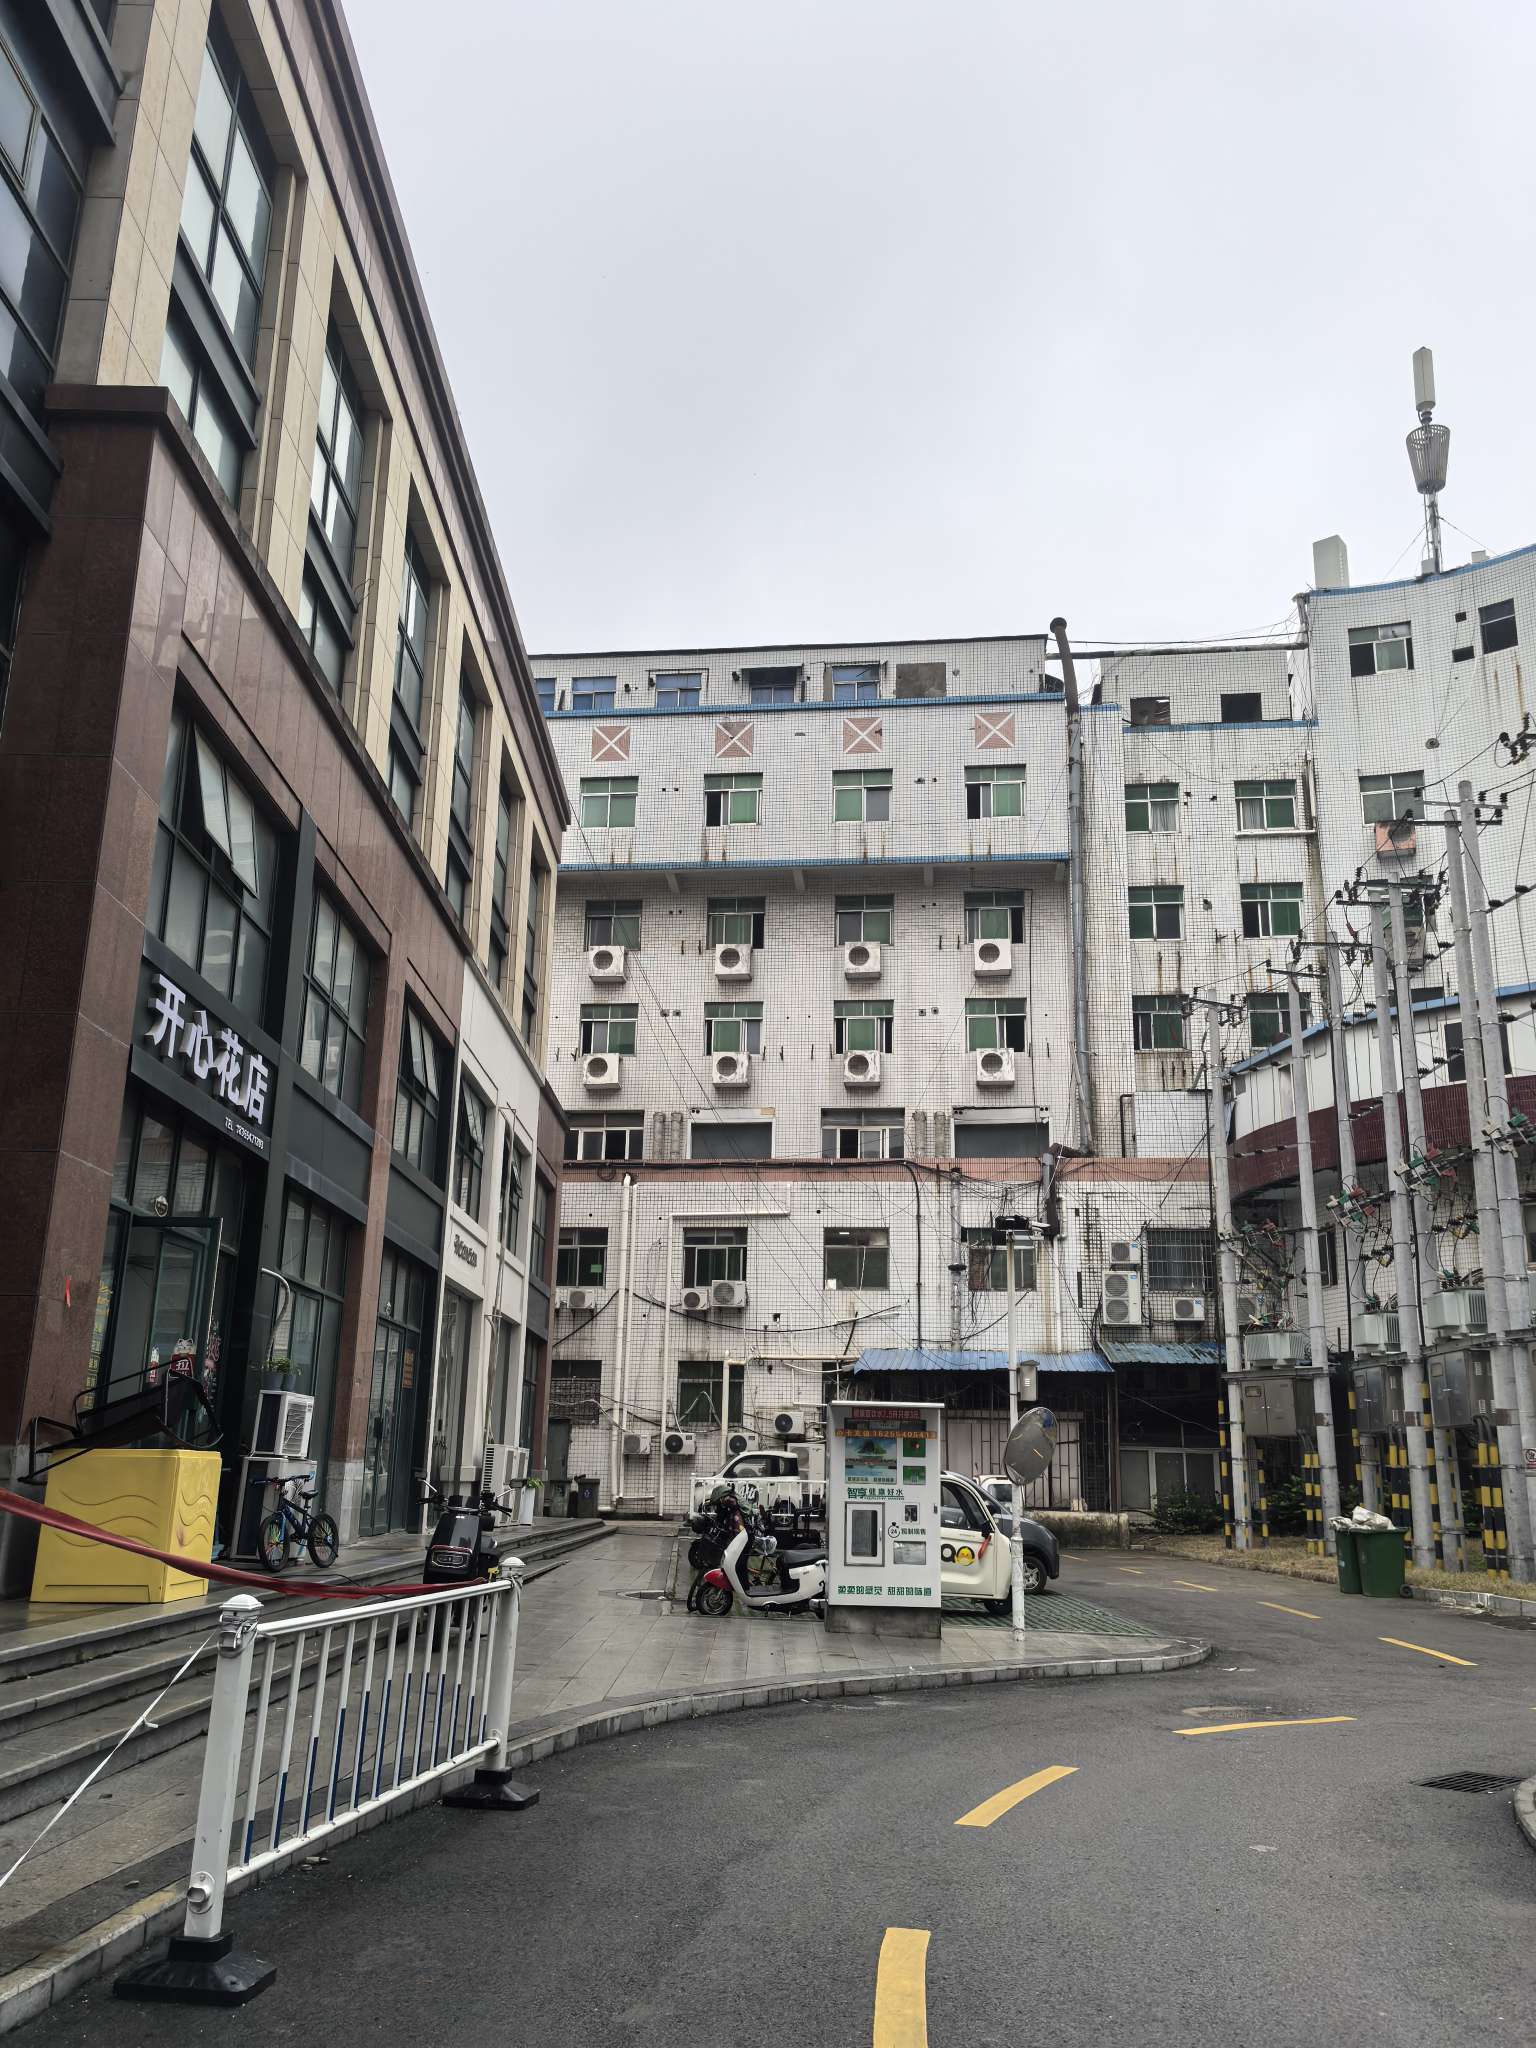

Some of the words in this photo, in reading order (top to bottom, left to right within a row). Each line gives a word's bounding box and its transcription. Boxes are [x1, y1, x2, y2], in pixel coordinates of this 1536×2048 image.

[145, 973, 269, 1125] 开心花店
[225, 1116, 234, 1131] TEL
[837, 1585, 883, 1596] 柔柔的感觉
[887, 1586, 932, 1597] 甜甜的味道
